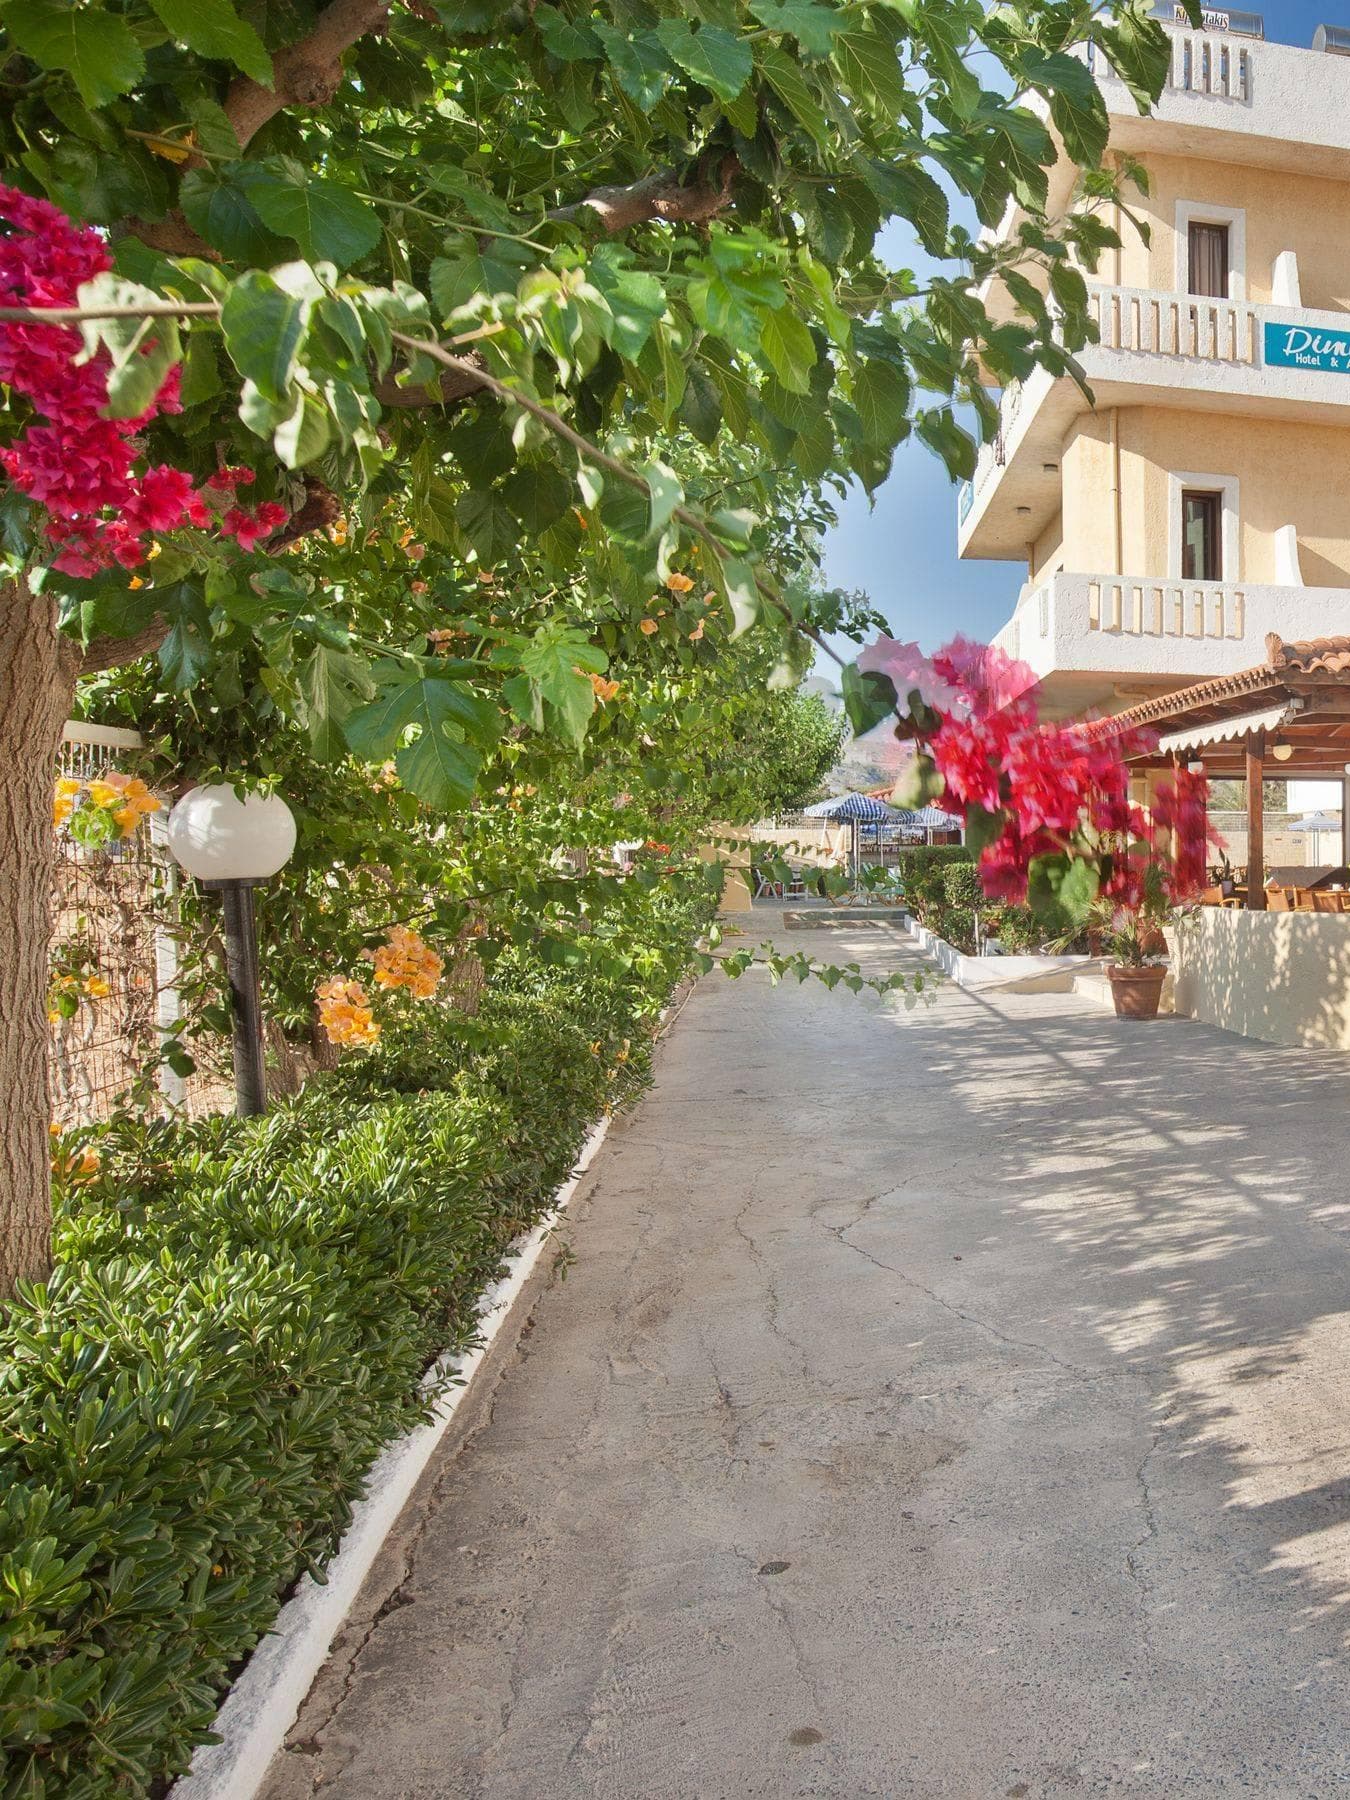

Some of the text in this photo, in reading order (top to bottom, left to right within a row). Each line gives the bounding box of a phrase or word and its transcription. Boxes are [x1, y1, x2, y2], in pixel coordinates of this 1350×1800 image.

[1176, 7, 1228, 28] Kipotakis
[1295, 353, 1320, 365] Hotel
[1330, 357, 1338, 367] &
